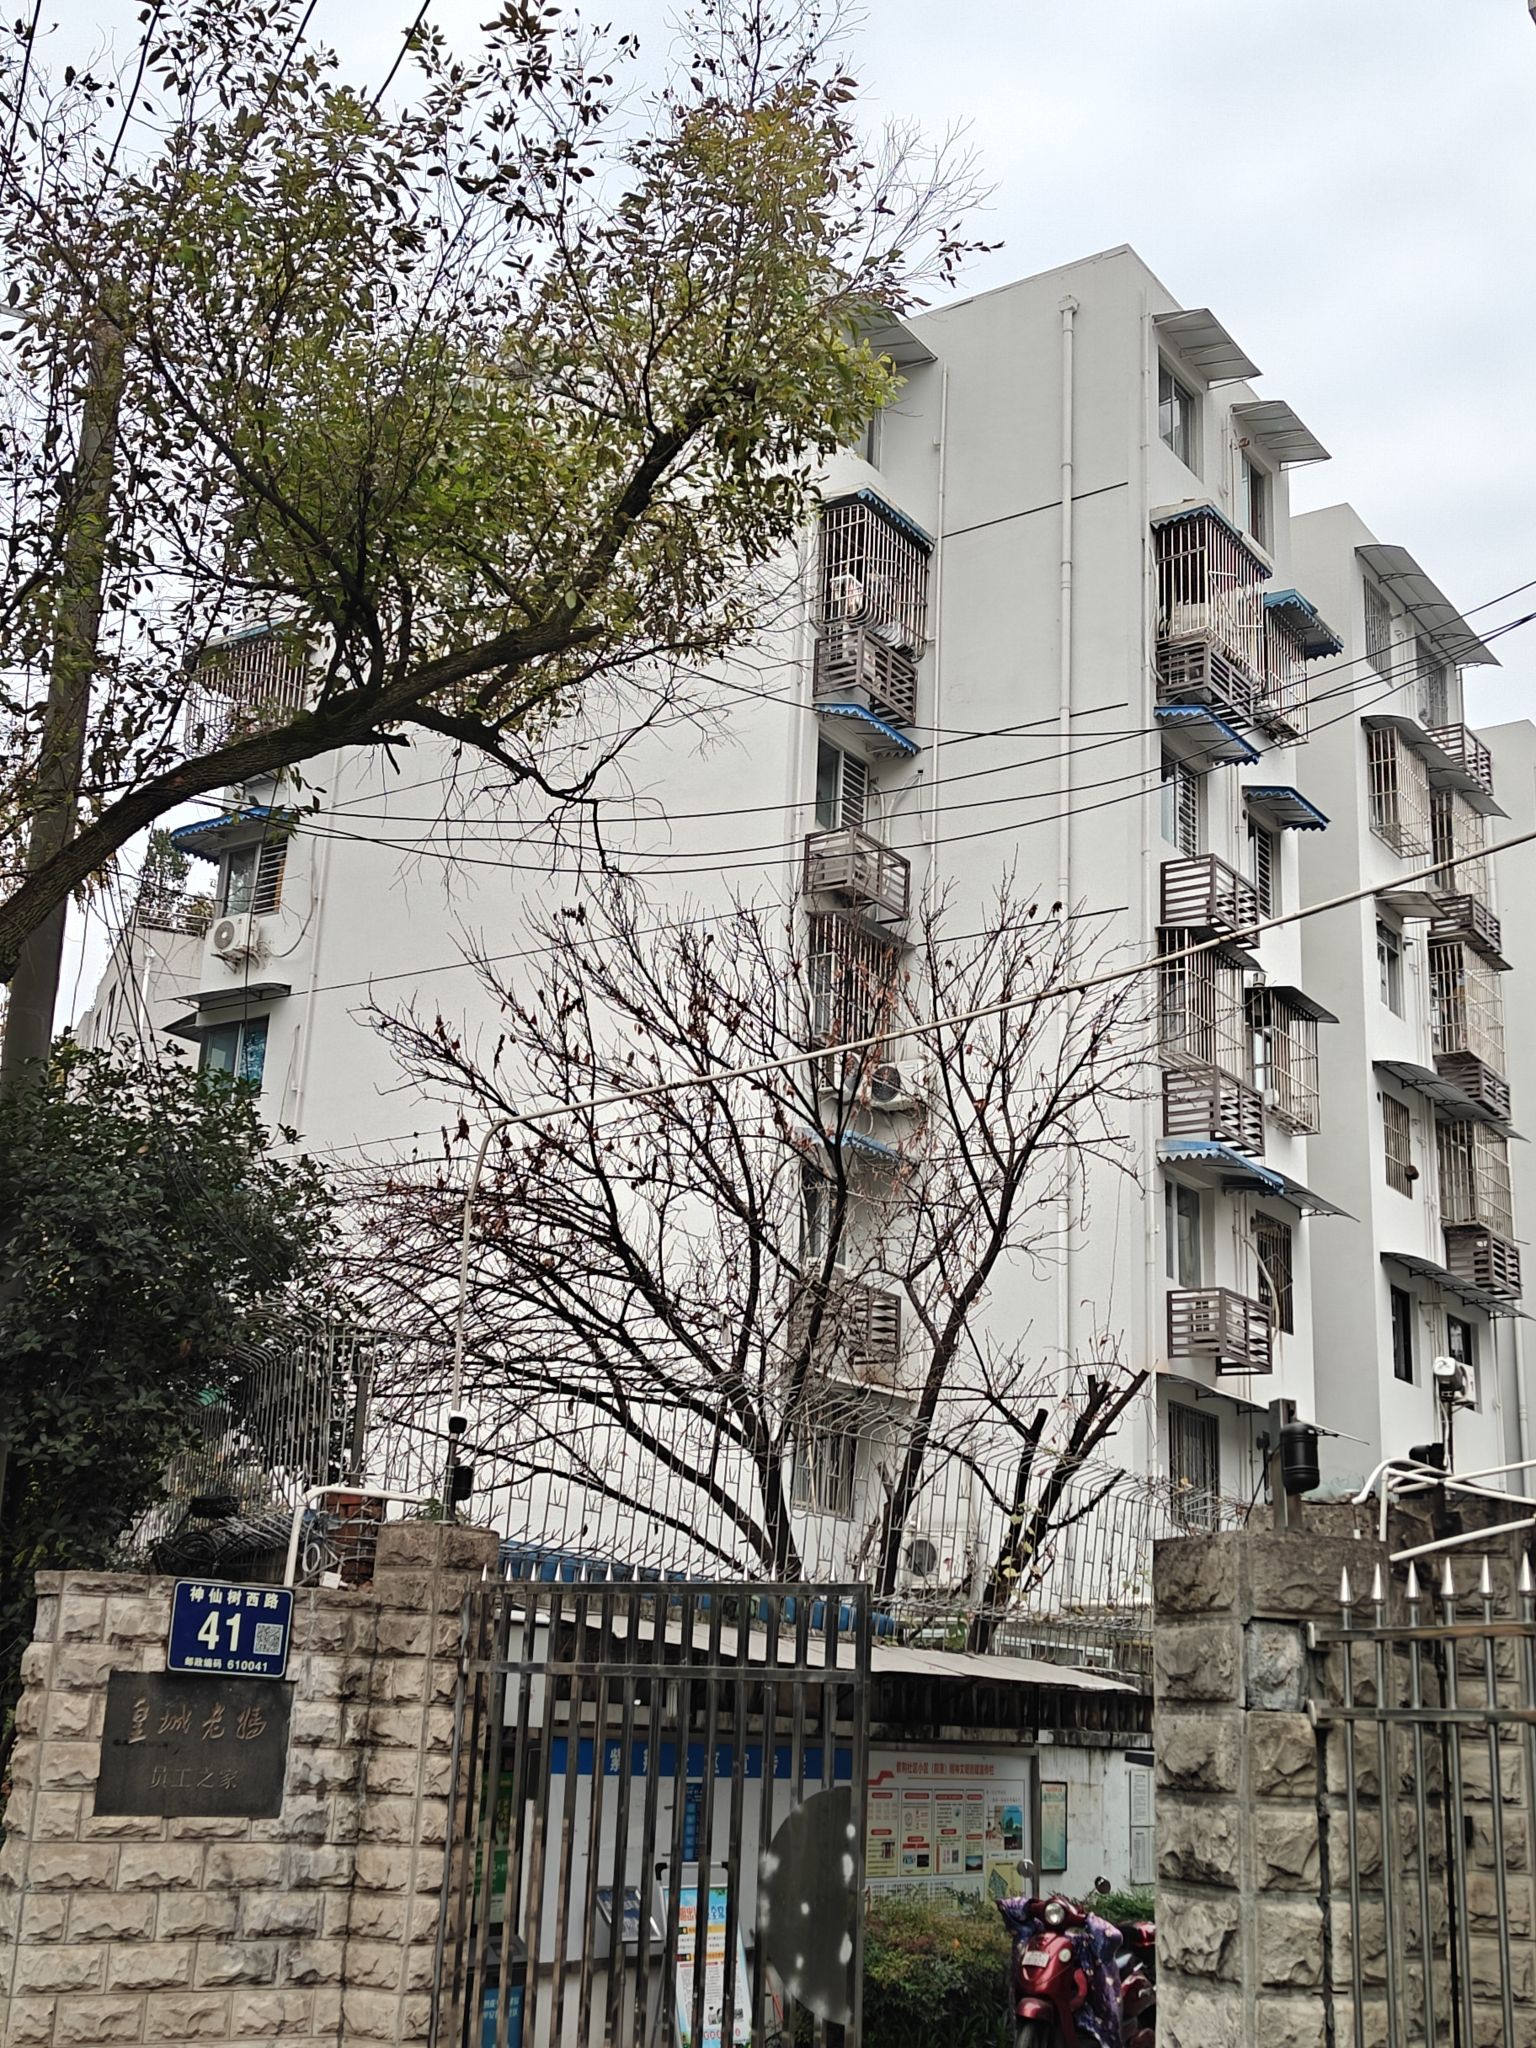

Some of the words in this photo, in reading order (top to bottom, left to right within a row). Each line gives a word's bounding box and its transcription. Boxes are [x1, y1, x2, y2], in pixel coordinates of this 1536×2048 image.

[189, 1585, 279, 1610] 神仙树西路
[197, 1610, 242, 1652] 41
[184, 1656, 222, 1669] 邮政编码
[227, 1659, 268, 1672] 610041
[149, 1765, 240, 1790] 员工之家
